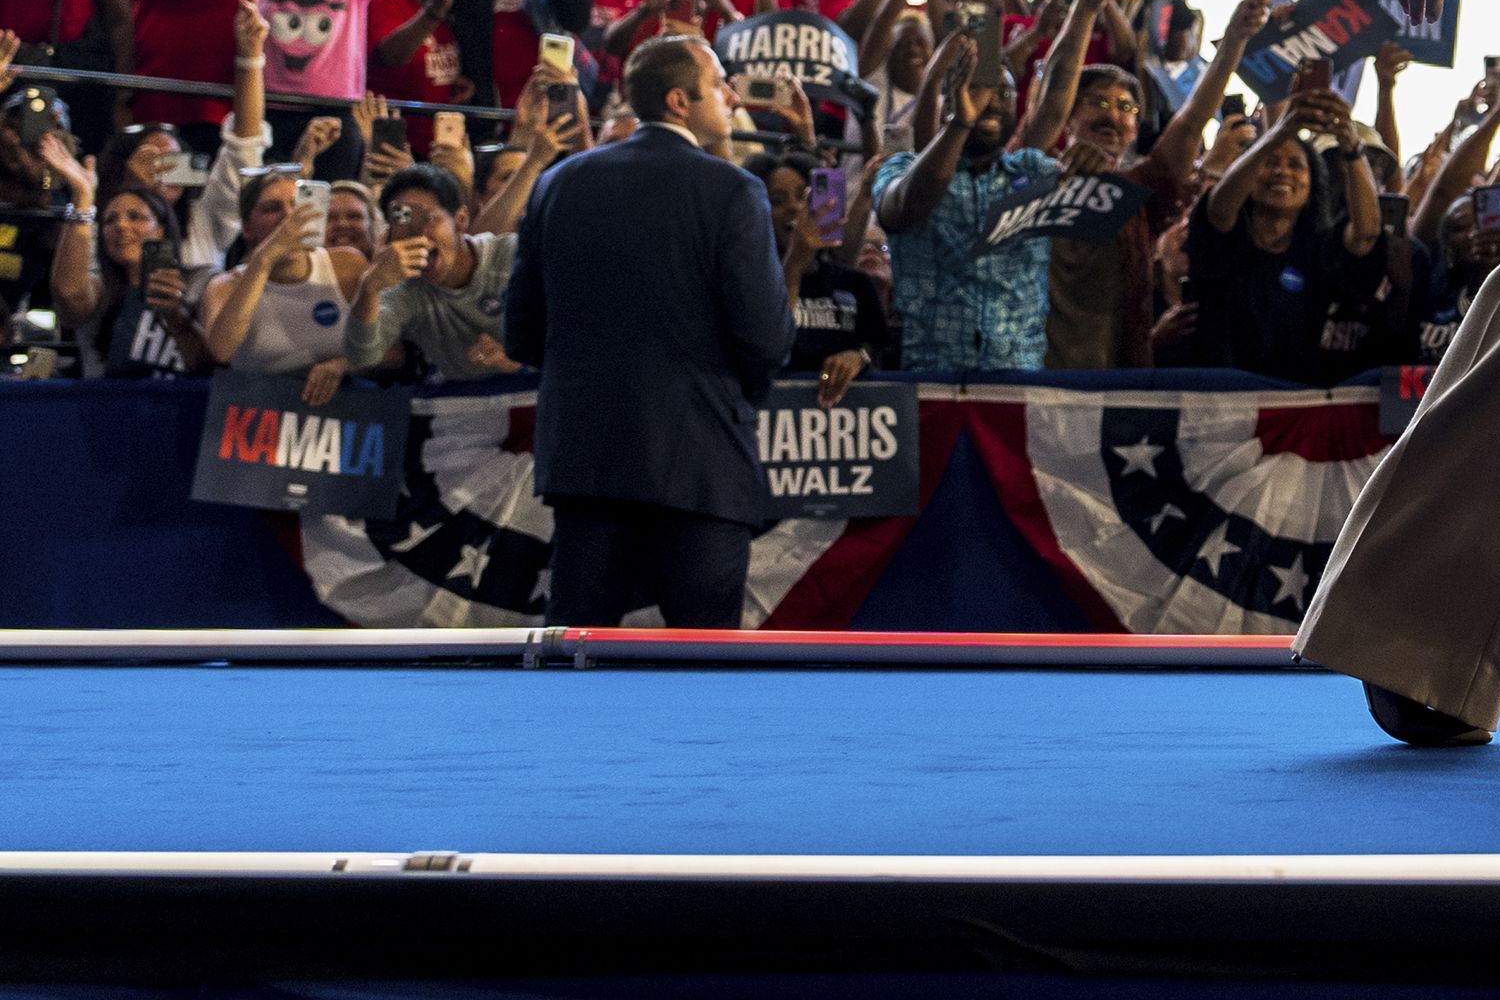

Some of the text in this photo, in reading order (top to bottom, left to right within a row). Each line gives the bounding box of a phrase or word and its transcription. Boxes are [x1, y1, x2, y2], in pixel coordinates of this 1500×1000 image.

[726, 23, 849, 72] HARRIS
[218, 404, 384, 478] KAMALA
[766, 466, 874, 497] WALZ
